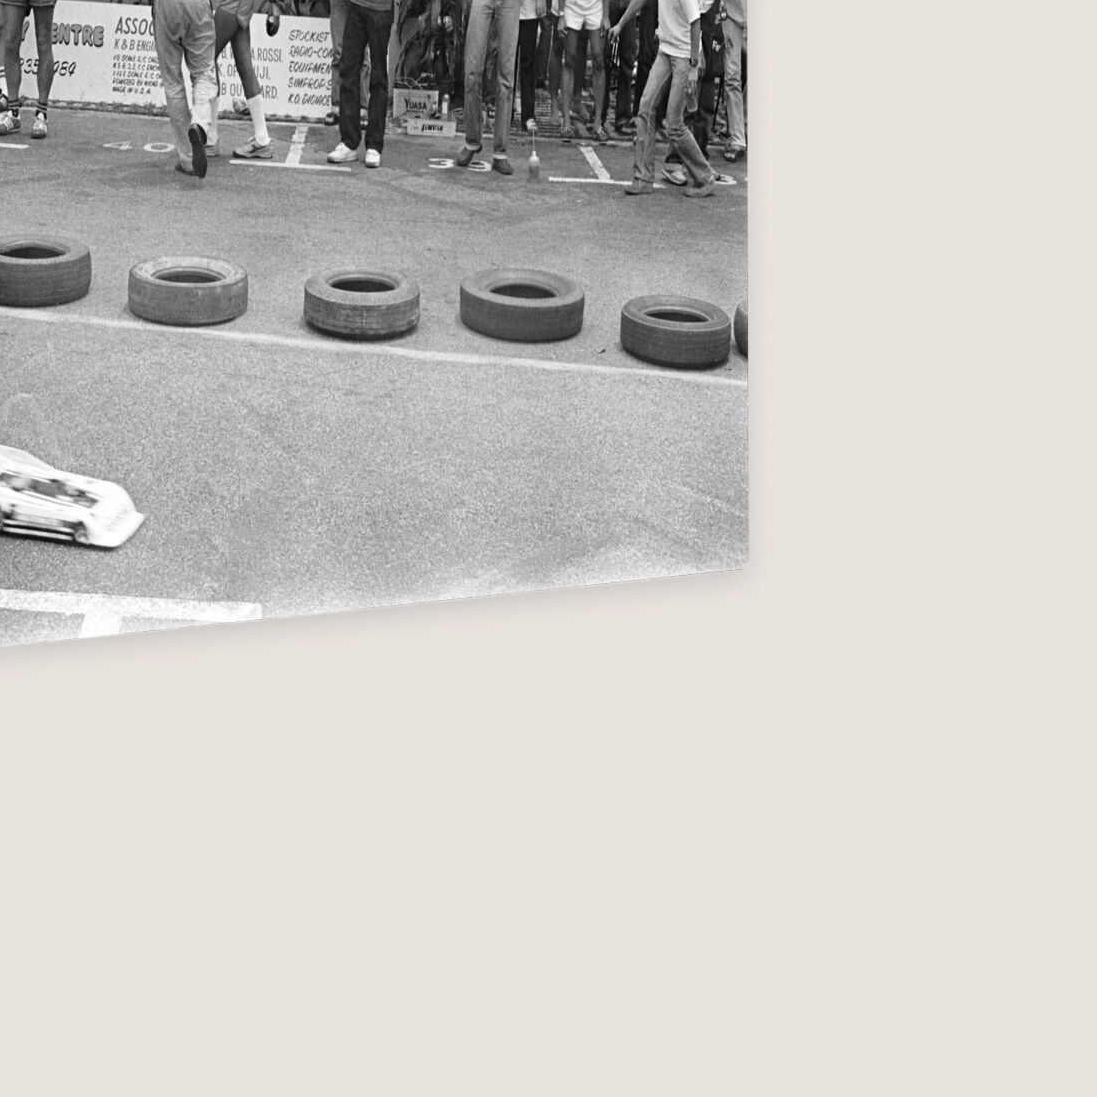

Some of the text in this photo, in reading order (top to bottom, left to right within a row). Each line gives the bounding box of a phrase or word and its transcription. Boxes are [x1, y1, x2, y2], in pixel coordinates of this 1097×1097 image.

[51, 23, 104, 47] ENTRE
[289, 61, 332, 74] EQUIPMEN
[404, 97, 427, 110] YUASA
